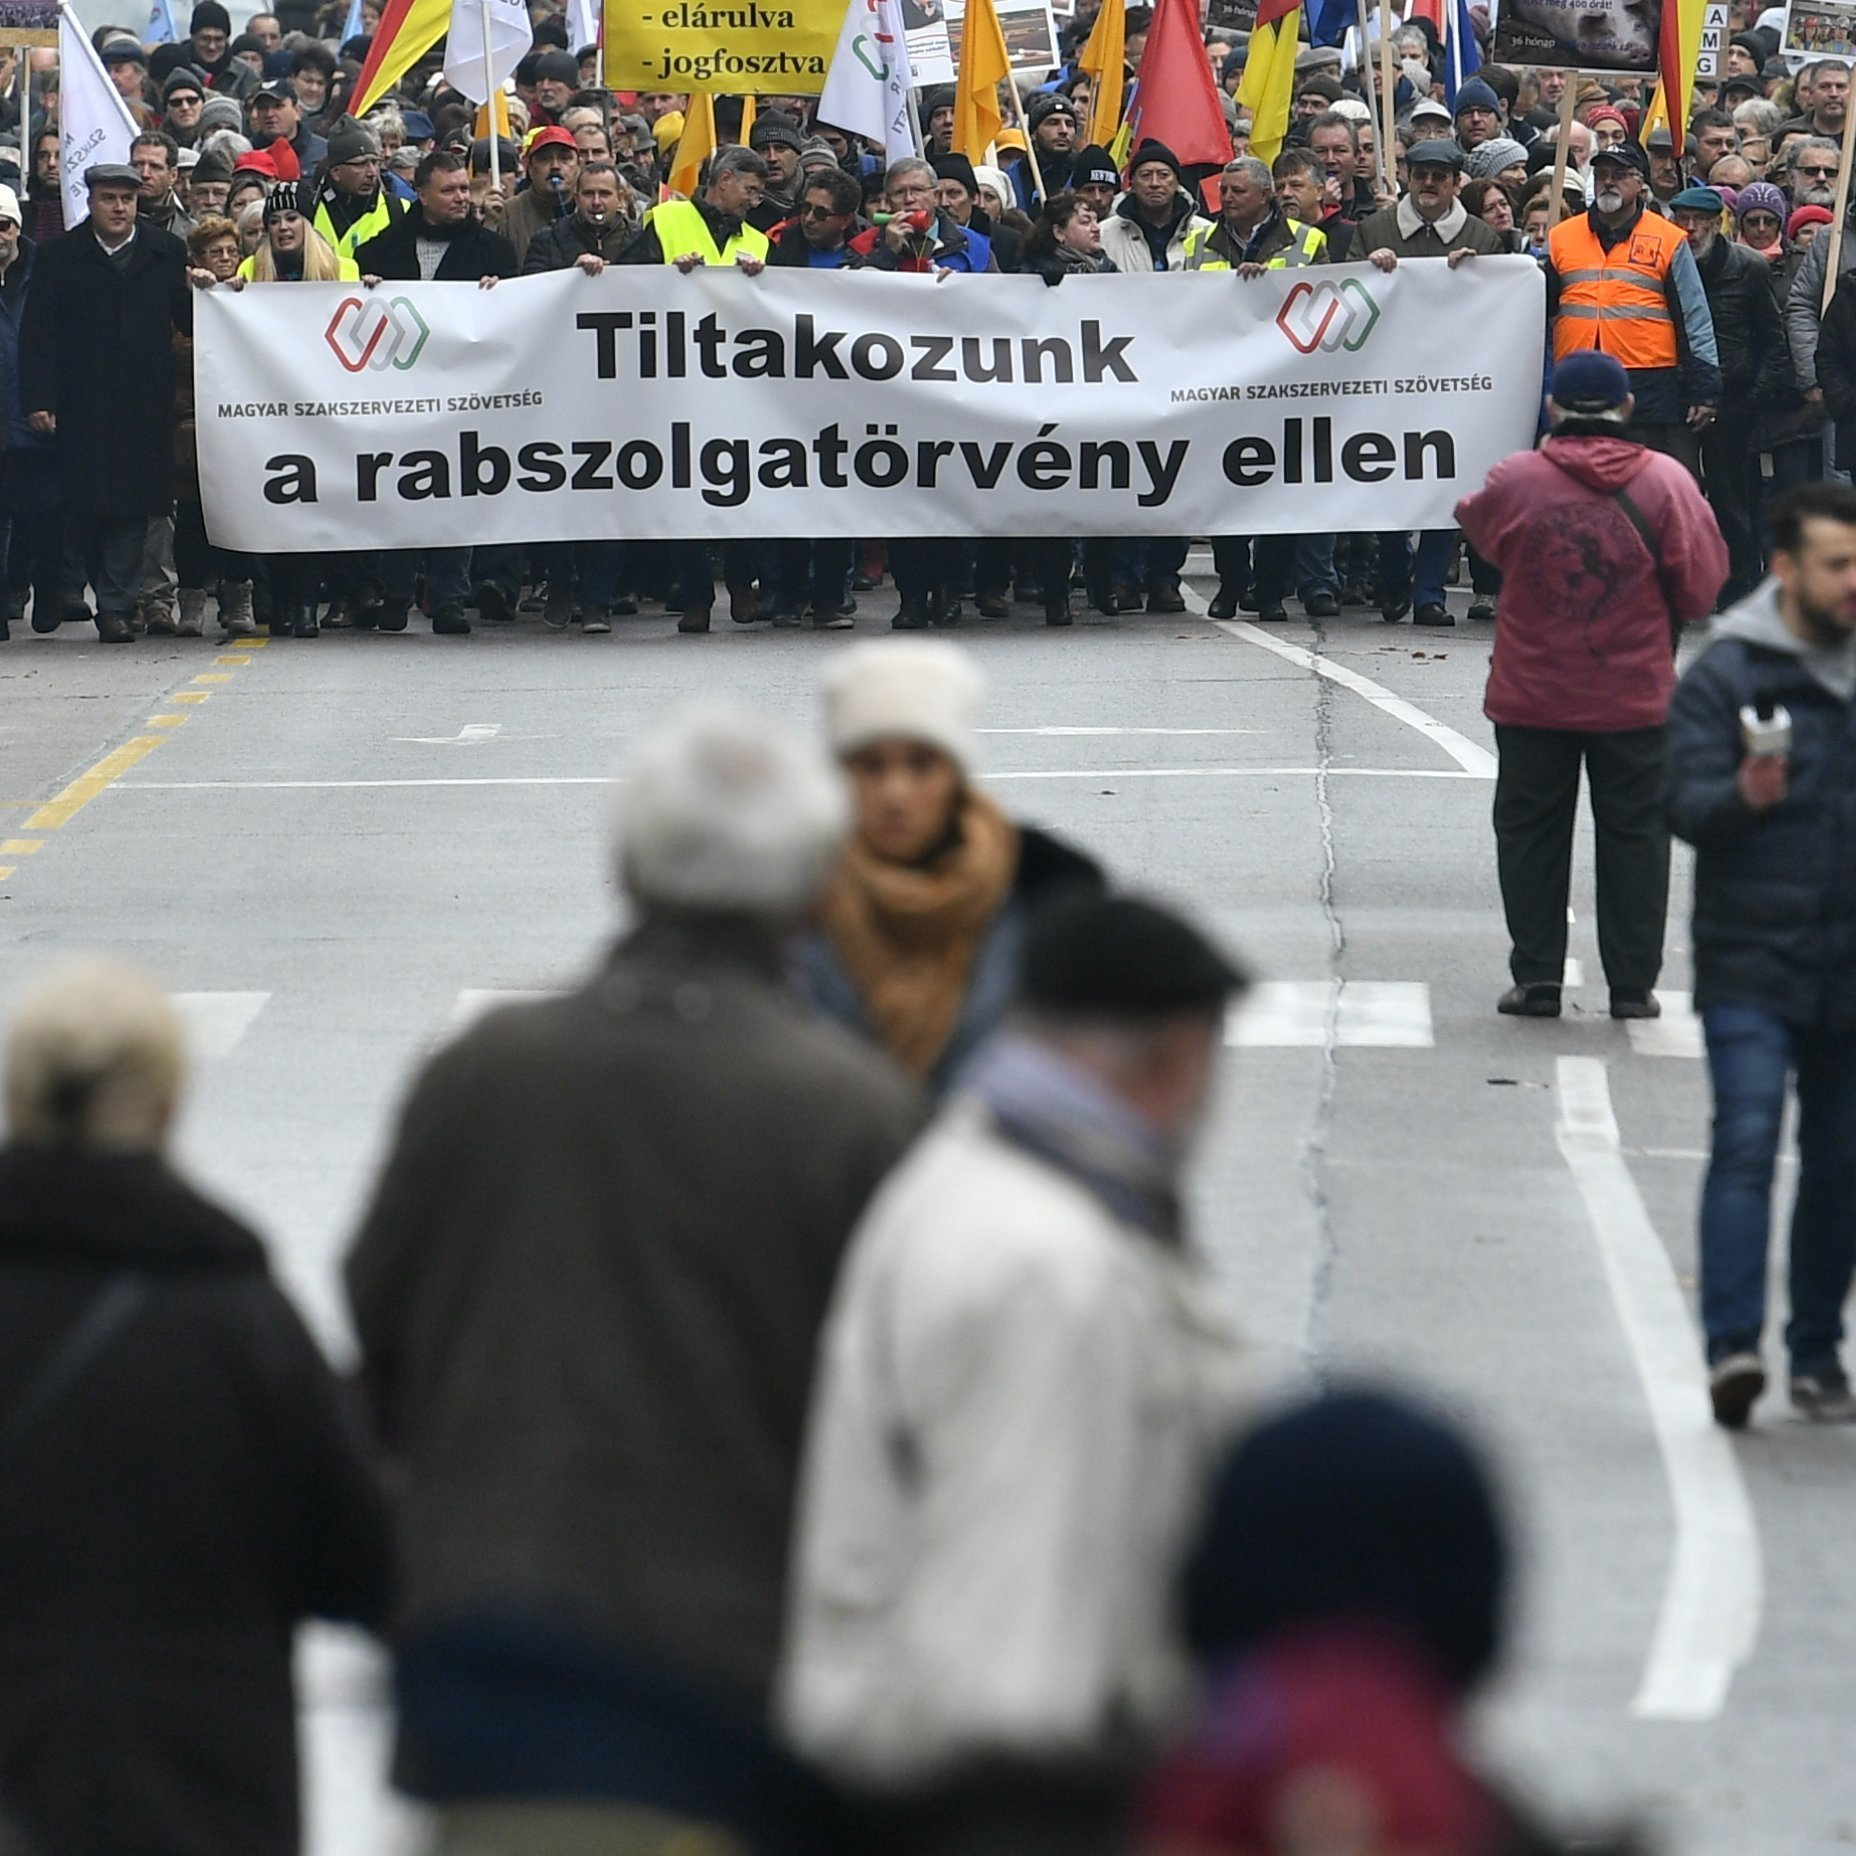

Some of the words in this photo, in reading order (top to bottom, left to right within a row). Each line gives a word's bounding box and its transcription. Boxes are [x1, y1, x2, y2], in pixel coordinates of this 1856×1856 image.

[661, 2, 794, 29] elárulva
[1234, 5, 1257, 18] hóna
[1710, 9, 1724, 25] A
[1510, 35, 1523, 48] 36
[1524, 35, 1556, 49] hónap
[1702, 33, 1717, 48] M
[658, 48, 826, 79] jogfosztva
[576, 310, 1138, 384] Tiltakozunk
[1170, 385, 1241, 403] MAGYAR
[1246, 379, 1389, 400] SZAKSZERVEZETI
[1393, 372, 1493, 394] SZÖVETSÉG
[217, 402, 289, 419] MAGYAR
[293, 397, 442, 417] SZAKSZERVEZETI
[447, 389, 544, 412] SZÖVETSÉG
[262, 451, 319, 505] a
[355, 421, 1190, 508] rabszolgatörvény
[1221, 416, 1456, 488] ellen
